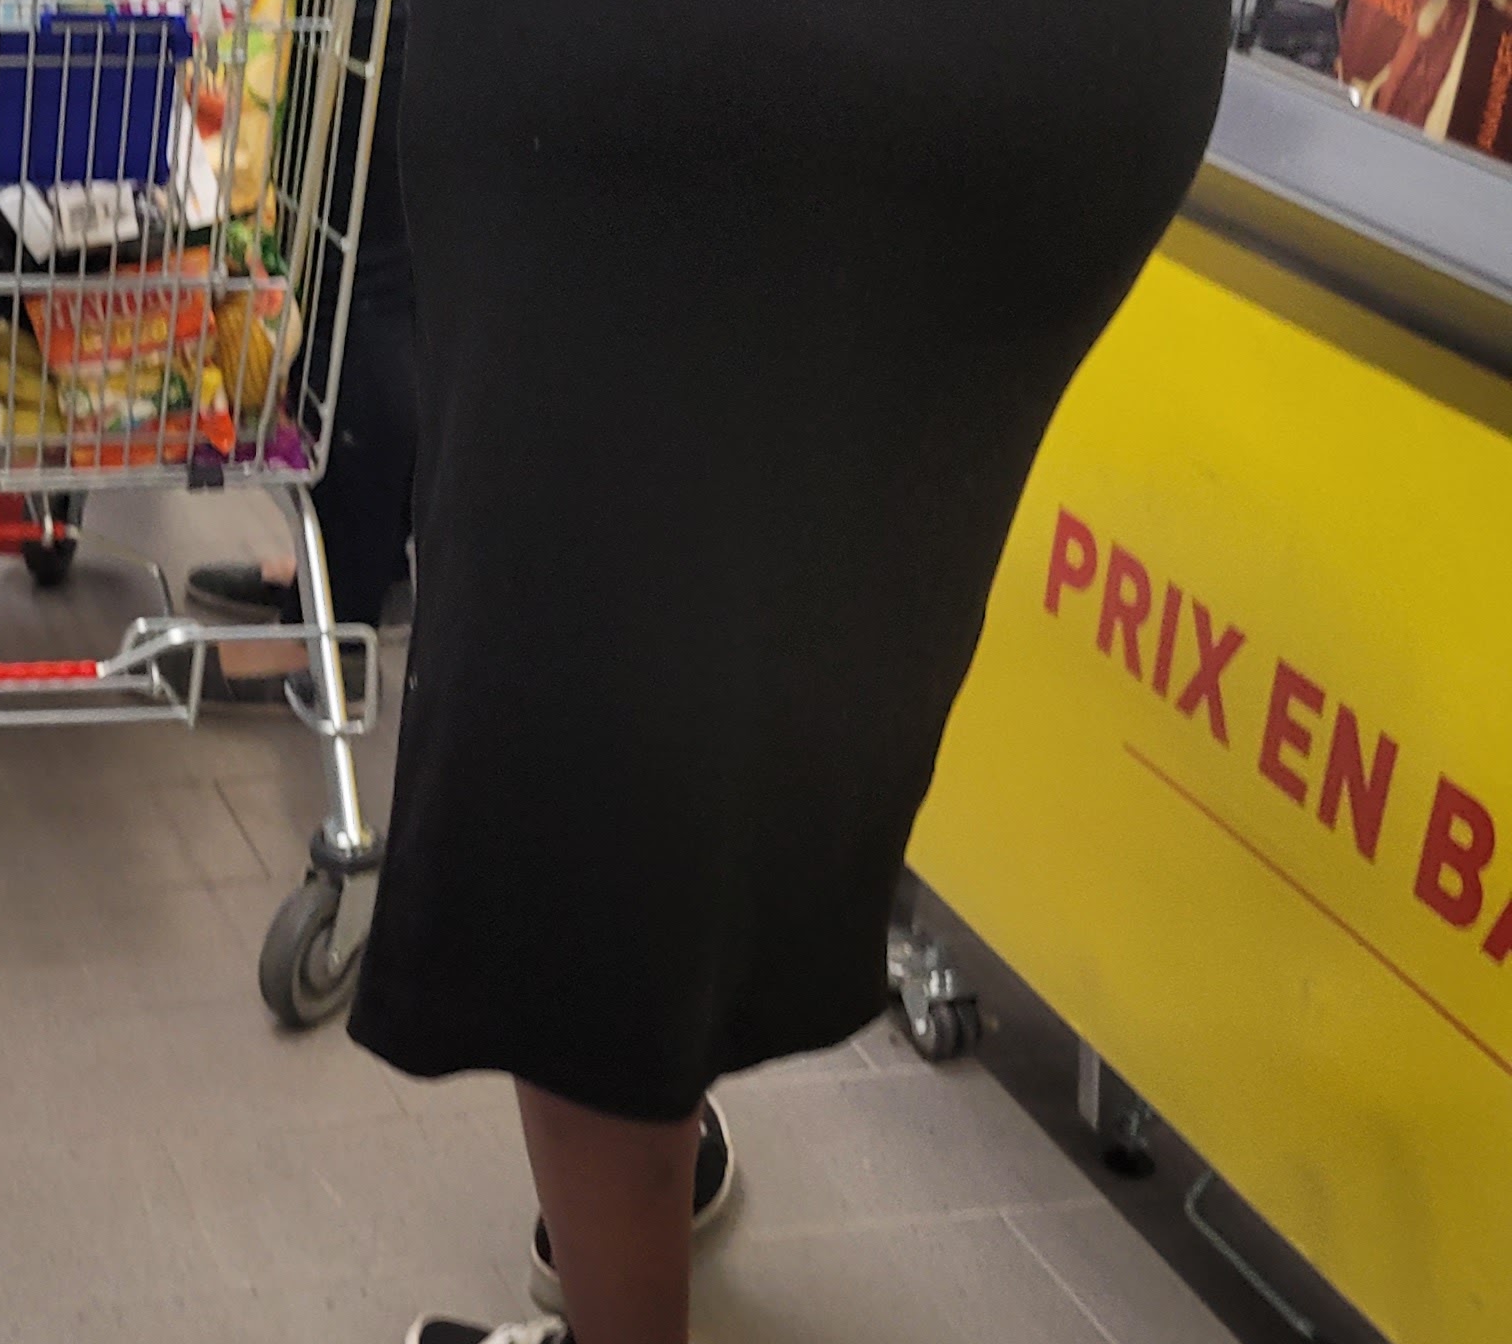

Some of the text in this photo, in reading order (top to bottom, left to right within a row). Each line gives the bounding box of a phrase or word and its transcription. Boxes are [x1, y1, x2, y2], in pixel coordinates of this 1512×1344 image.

[1043, 503, 1512, 966] PRIX EN B
